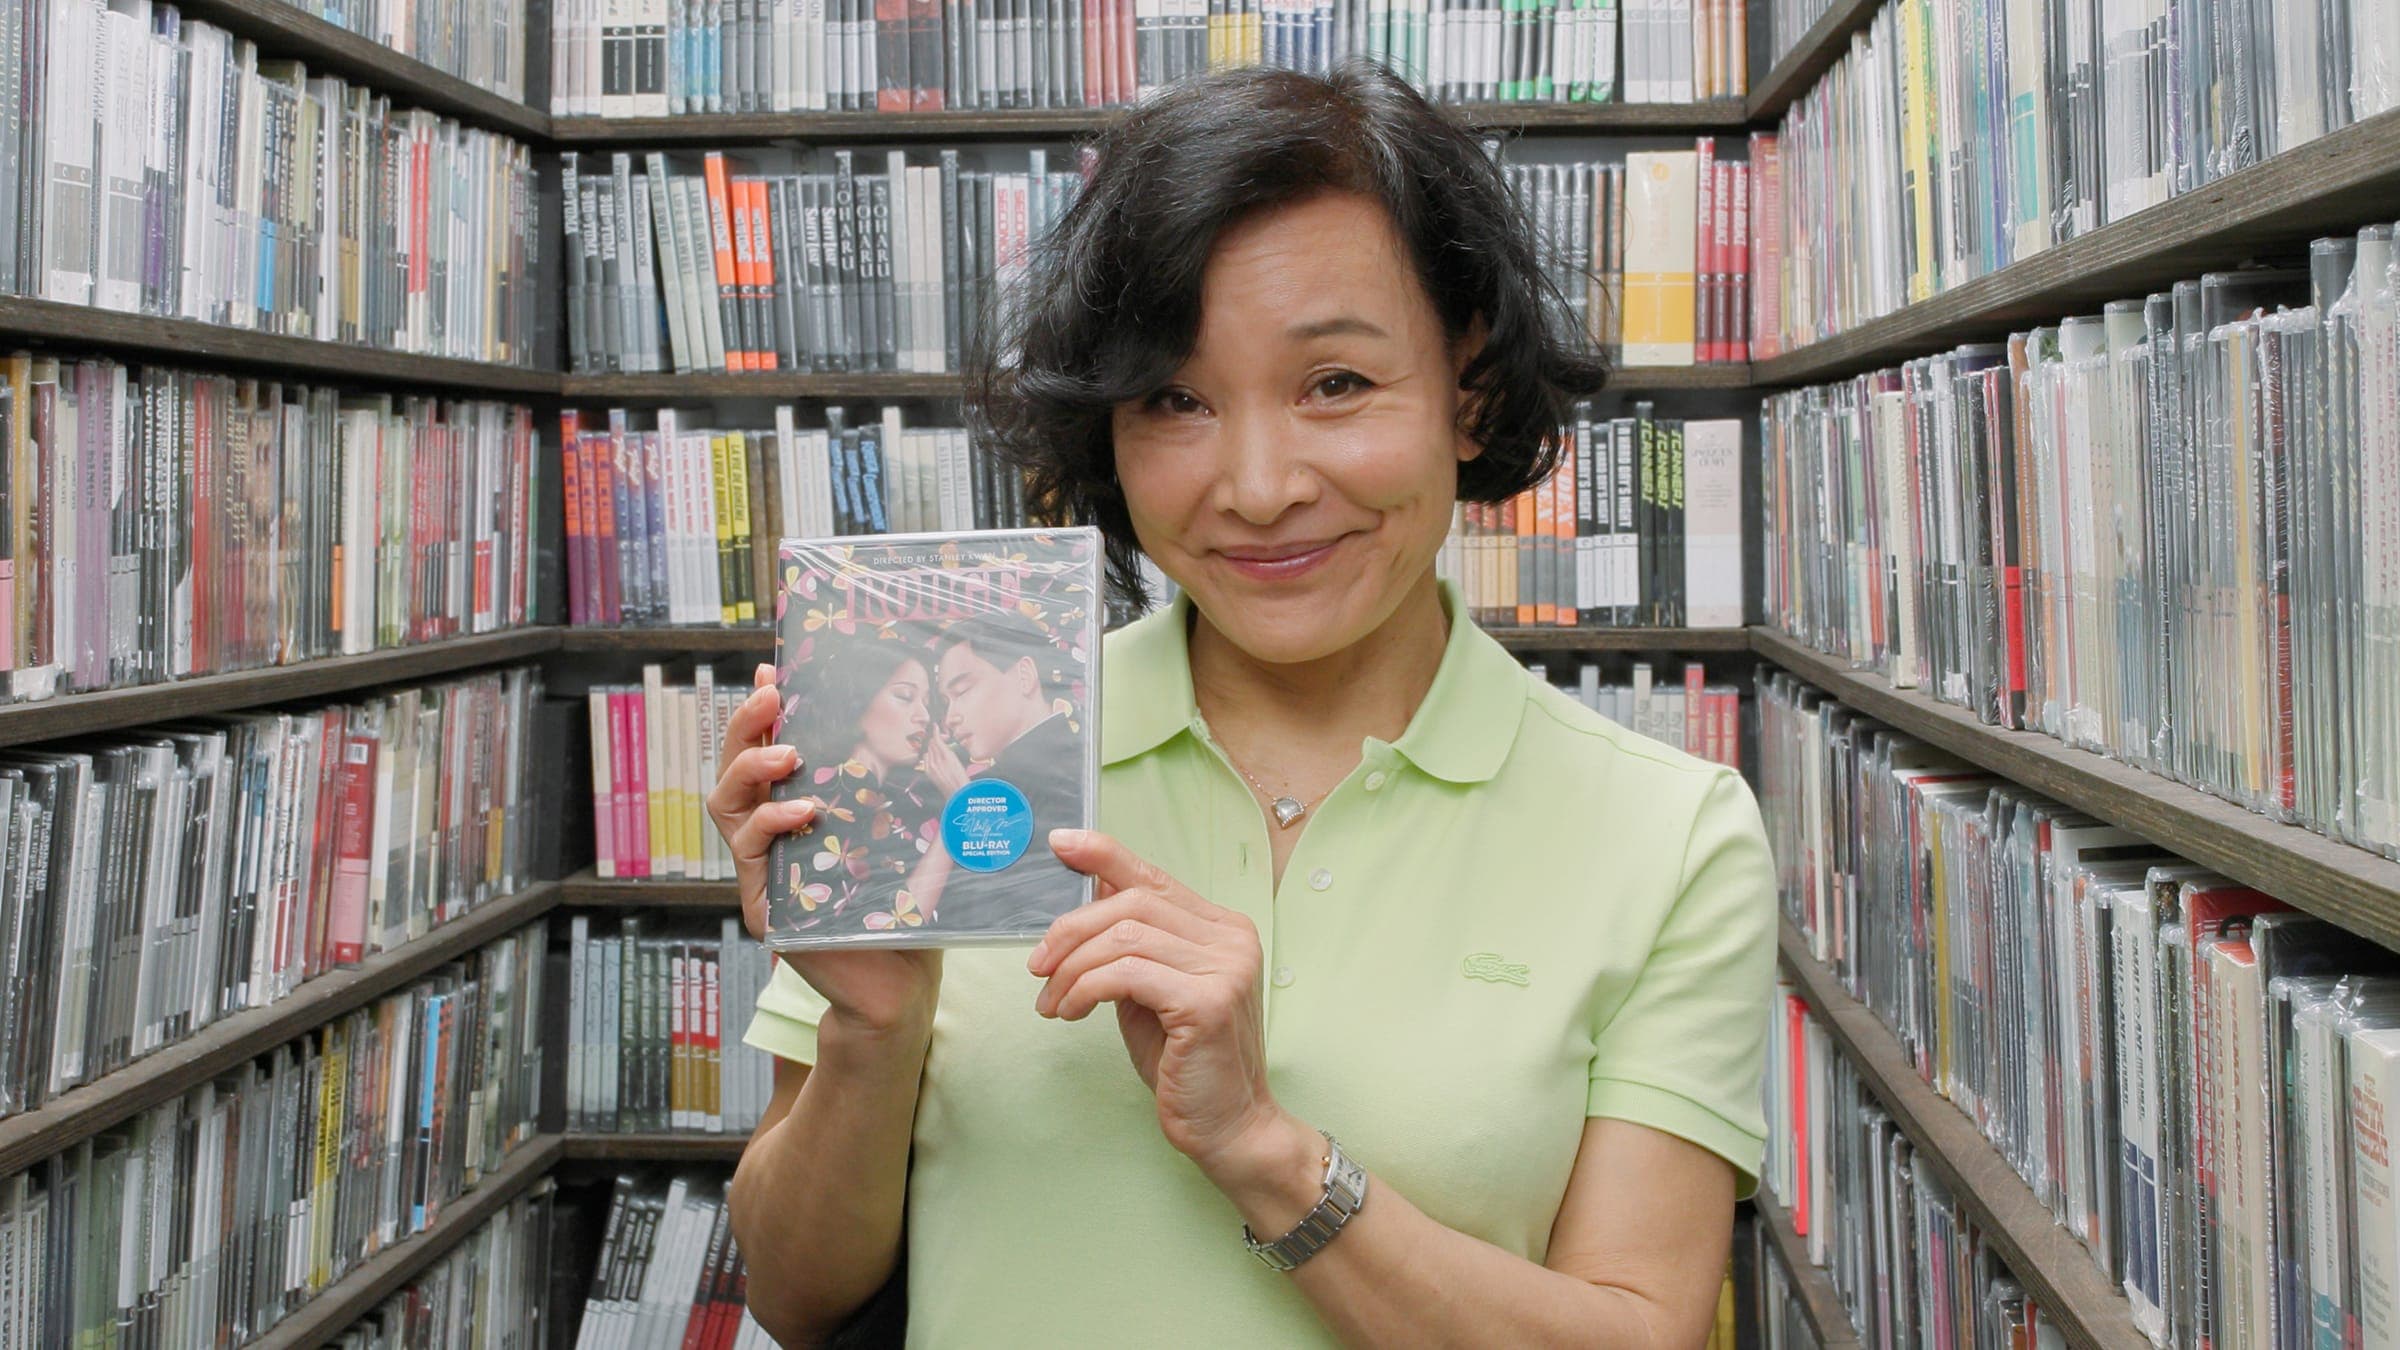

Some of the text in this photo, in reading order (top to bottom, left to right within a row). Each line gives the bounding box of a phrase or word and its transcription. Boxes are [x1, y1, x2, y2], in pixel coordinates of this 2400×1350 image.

[564, 199, 578, 235] YUMA
[618, 217, 628, 242] cool
[656, 207, 670, 246] SWEET
[837, 191, 854, 272] OHARU
[583, 222, 597, 258] YUMA
[602, 225, 615, 260] YUMA
[638, 240, 648, 266] cool
[856, 205, 873, 278] OHARU
[873, 204, 890, 277] OHARU
[2387, 373, 2395, 421] GIRL
[144, 384, 153, 512] YOUTH BEAST
[1617, 436, 1631, 464] HARD
[1640, 418, 1653, 504] SCANNERS
[2389, 429, 2397, 500] CAN'T
[1656, 430, 1669, 510] SCANNERS
[1670, 429, 1683, 510] SCANNERS
[1579, 490, 1592, 520] NIGHT
[1597, 498, 1608, 524] NIGHT
[1618, 496, 1632, 528] NIGHT
[873, 555, 913, 565] DIRECTED
[916, 555, 926, 563] BY
[929, 553, 967, 562] STANLEY
[2392, 570, 2398, 590] IT
[699, 686, 713, 764] BIG CHILL
[717, 706, 728, 733] BIG
[967, 805, 1008, 813] APPROVED
[776, 841, 785, 884] COLLECTION
[963, 840, 1010, 850] BLU-RAY
[2135, 1022, 2143, 1054] AXE
[2231, 987, 2240, 1087] THELMA
